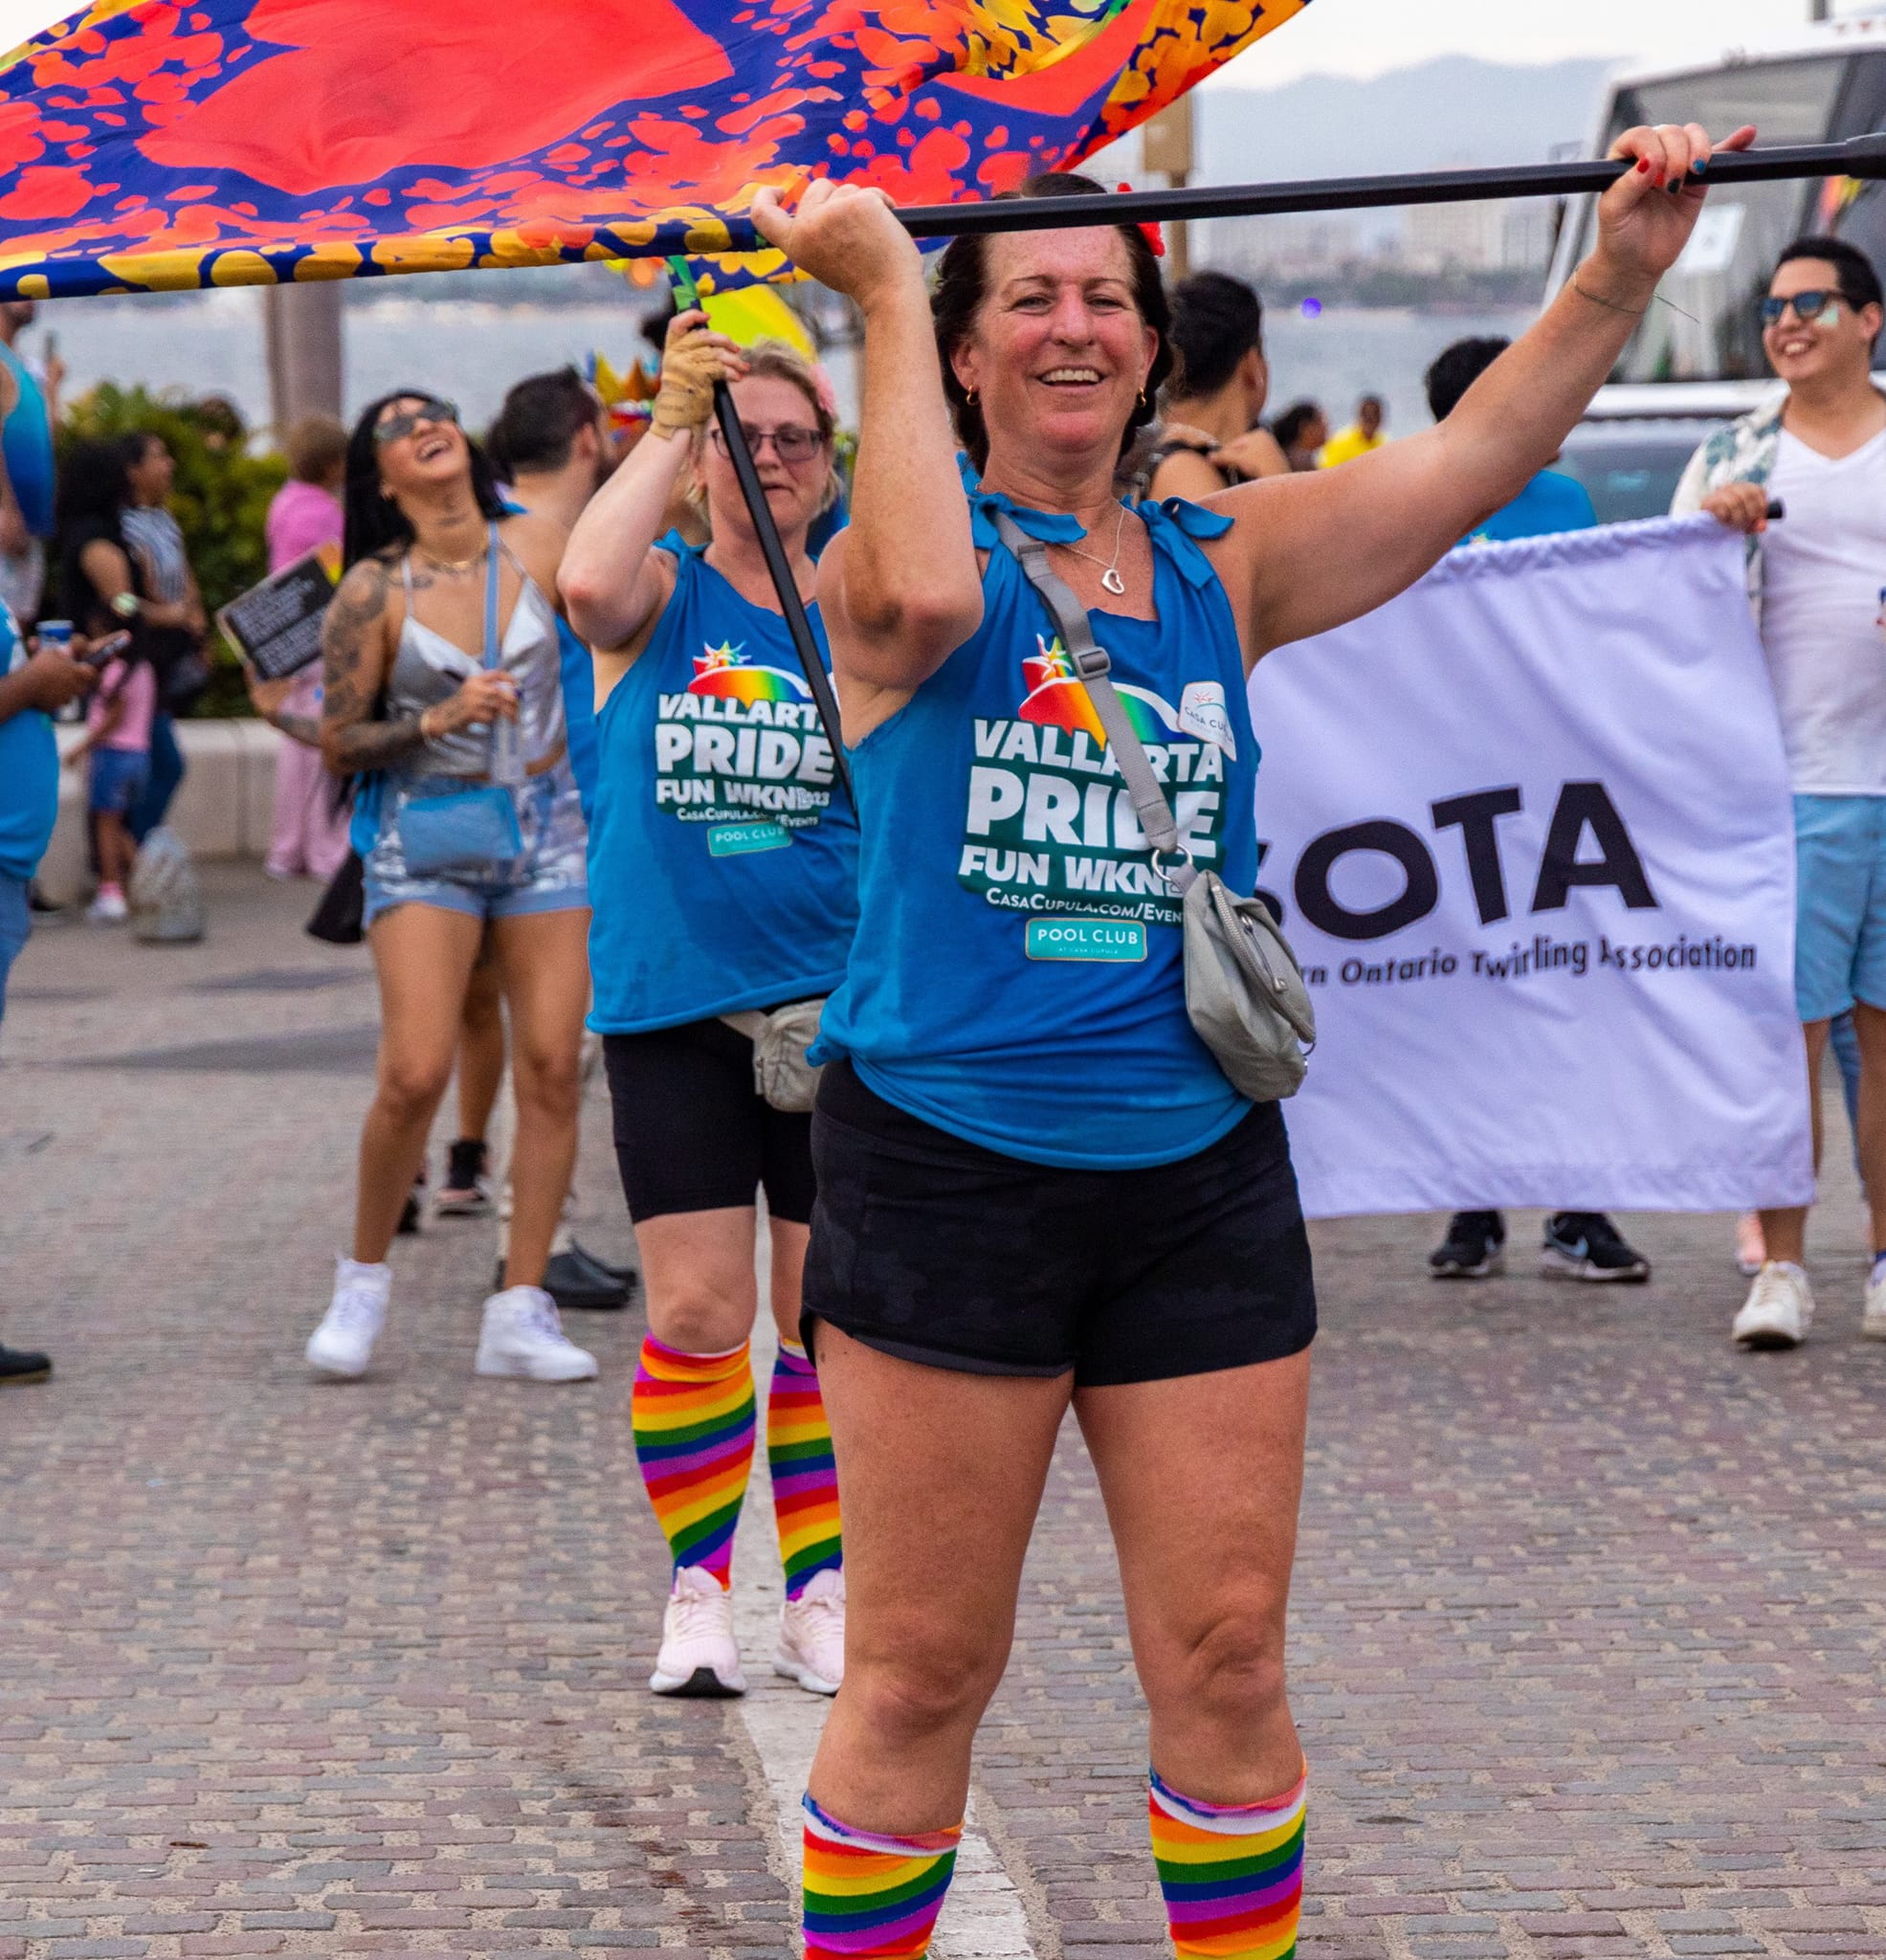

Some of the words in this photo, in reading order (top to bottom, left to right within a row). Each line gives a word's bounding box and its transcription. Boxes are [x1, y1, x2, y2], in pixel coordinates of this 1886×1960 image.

[658, 692, 826, 733] VALLART
[655, 724, 836, 785] PRIDE
[655, 778, 716, 805] FUN
[715, 831, 748, 843] POOL
[958, 844, 1050, 886] FUN
[1255, 780, 1659, 941] OTA
[1037, 927, 1088, 943] POOL
[1092, 928, 1138, 946] CLUB
[1341, 947, 1457, 985] Ontario
[1470, 933, 1587, 978] Twirling
